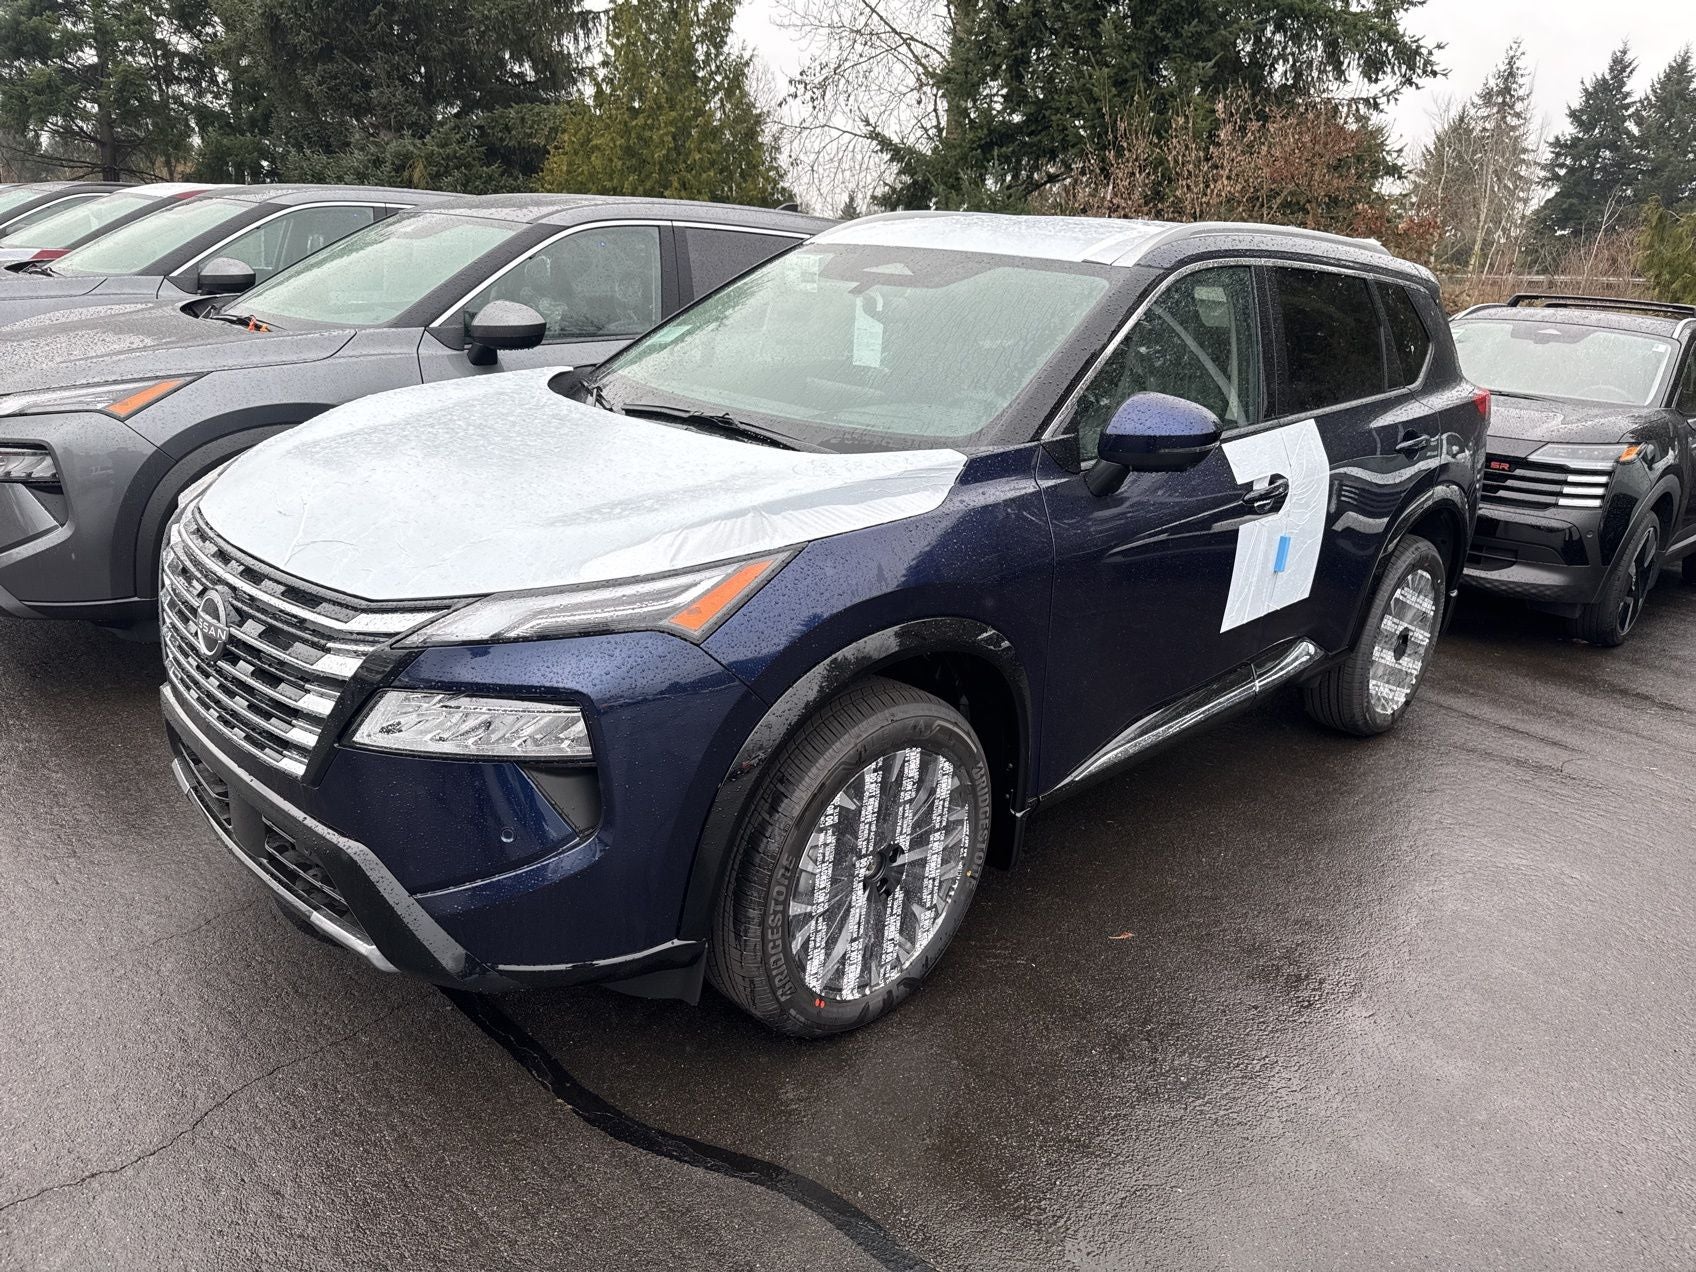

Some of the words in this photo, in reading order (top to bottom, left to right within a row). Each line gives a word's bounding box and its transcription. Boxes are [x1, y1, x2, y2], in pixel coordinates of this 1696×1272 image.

[1491, 461, 1510, 470] SR
[972, 761, 992, 891] BRIDGESTONE
[765, 855, 797, 1002] BRIDGESTONE
